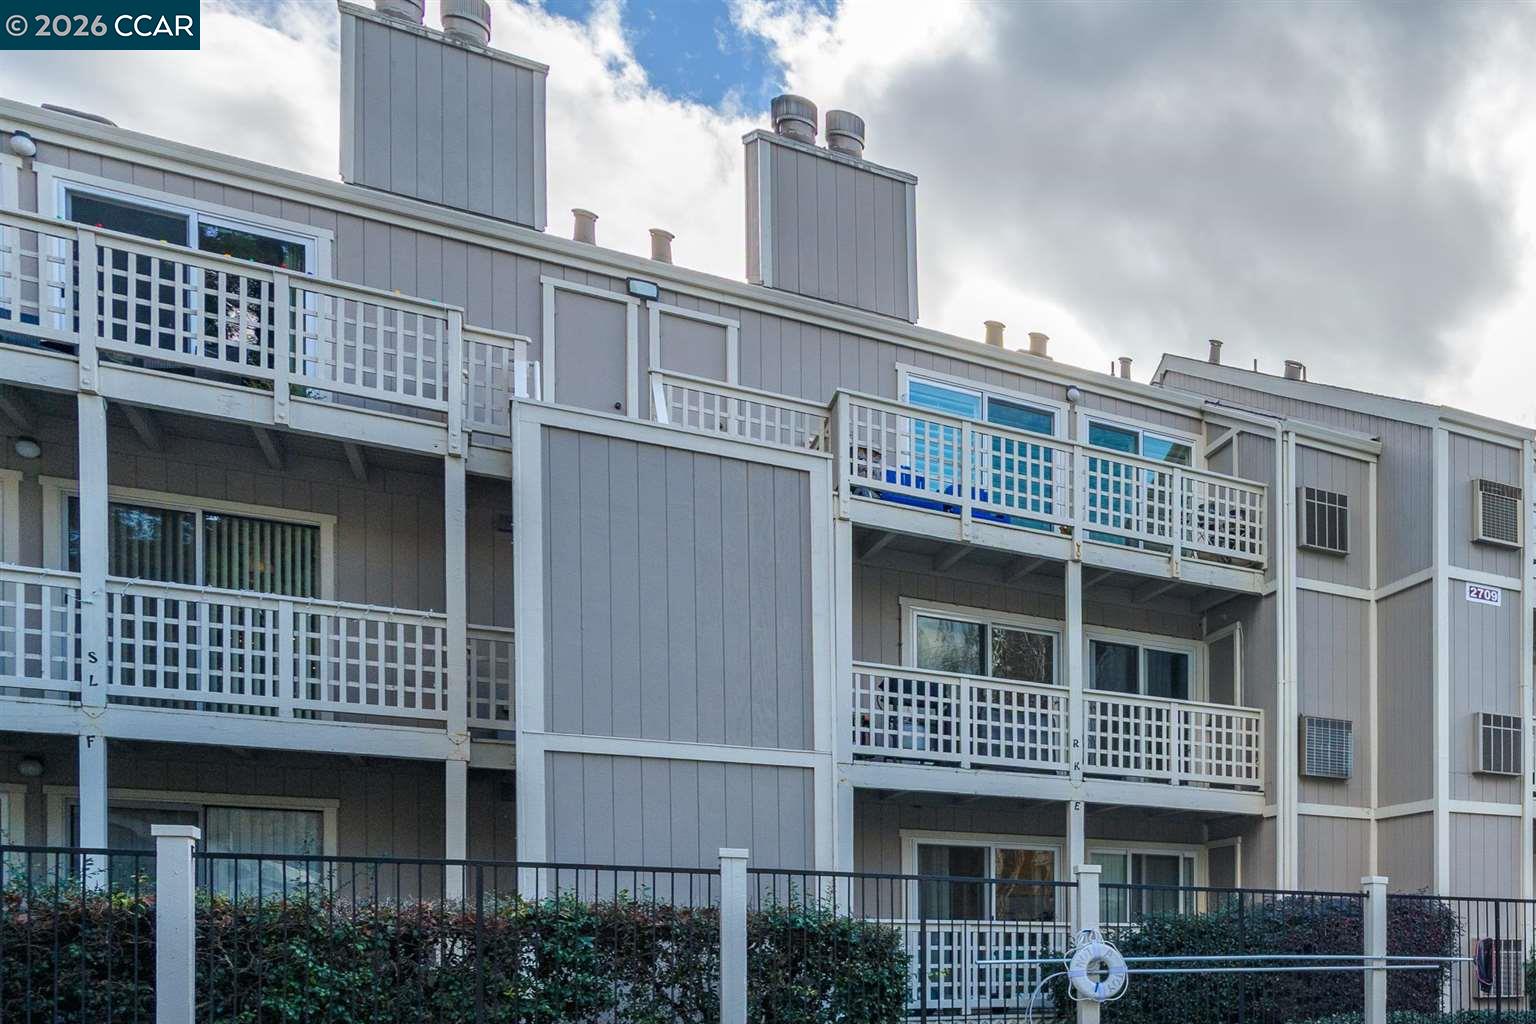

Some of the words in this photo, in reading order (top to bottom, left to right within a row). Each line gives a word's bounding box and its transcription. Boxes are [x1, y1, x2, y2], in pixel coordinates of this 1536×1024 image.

[1470, 586, 1498, 602] 2709
[88, 651, 98, 664] S
[89, 674, 98, 687] L
[86, 735, 96, 749] F
[1072, 738, 1080, 748] R
